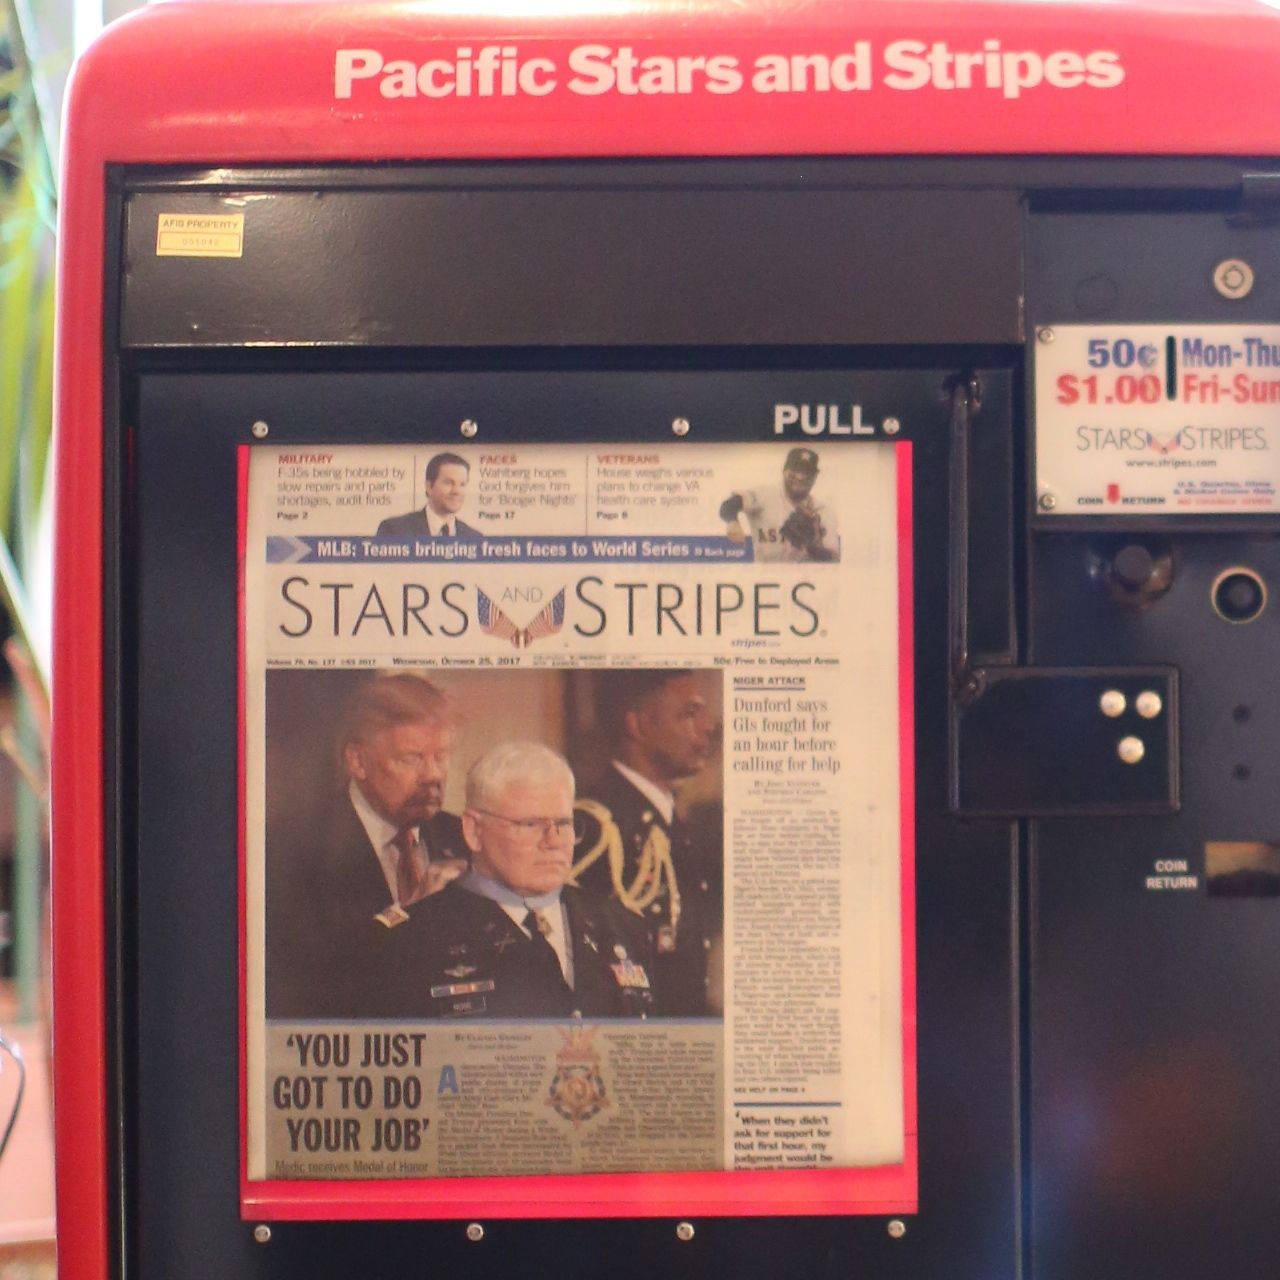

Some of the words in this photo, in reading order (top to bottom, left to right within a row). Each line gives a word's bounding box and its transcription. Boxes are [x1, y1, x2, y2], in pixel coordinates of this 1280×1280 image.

[333, 47, 556, 100] Pacific
[567, 44, 742, 95] Stars
[752, 41, 872, 93] and
[884, 39, 1125, 99] Stripes
[187, 220, 238, 229] PROPERTY
[1057, 374, 1162, 406] $1.00
[774, 404, 875, 435] PULL
[1077, 426, 1147, 451] STARS
[278, 454, 333, 464] MILITARY
[479, 455, 517, 464] FACES
[597, 455, 660, 464] VETERANS
[1126, 459, 1217, 470] www.stripes.com
[312, 468, 342, 480] being
[345, 468, 390, 478] hobbled
[392, 468, 405, 480] by
[479, 468, 530, 480] Wahlberg
[533, 468, 567, 480] hopes
[596, 468, 628, 478] House
[676, 468, 714, 478] various
[277, 482, 300, 492] slow
[305, 482, 340, 494] repairs
[344, 482, 365, 492] and
[368, 482, 396, 494] parts
[478, 482, 501, 492] God
[502, 482, 546, 493] forgives
[549, 482, 570, 492] him
[596, 482, 626, 493] plans
[629, 483, 639, 491] to
[642, 482, 681, 493] change
[684, 482, 700, 491] VA
[277, 496, 331, 507] shortages,
[335, 496, 361, 506] audit
[365, 496, 392, 506] finds
[478, 495, 494, 505] for
[596, 495, 630, 505] health
[633, 497, 656, 505] care
[659, 496, 699, 507] system
[1077, 497, 1104, 505] COIN
[1121, 497, 1166, 505] RETURN
[277, 512, 299, 521] Page
[317, 542, 356, 558] MLB:
[362, 542, 410, 558] Teams
[415, 541, 477, 560] bringing
[481, 541, 521, 557] fresh
[526, 542, 567, 557] faces
[572, 543, 588, 557] to
[592, 542, 637, 557] World
[641, 542, 690, 557] Series
[279, 576, 469, 637] STARS
[500, 586, 544, 604] AND
[573, 576, 820, 638] STRIPES
[496, 656, 521, 666] 2017
[770, 656, 812, 668] Deployed
[814, 656, 840, 666] Areas
[733, 676, 764, 685] NIGER
[768, 676, 807, 685] ATTACK
[733, 697, 791, 712] Dunford
[796, 700, 828, 717] says
[733, 717, 757, 733] GIs
[762, 717, 806, 736] fought
[812, 717, 831, 732] for
[733, 740, 751, 752] an
[756, 736, 789, 752] hour
[793, 736, 838, 752] before
[733, 756, 784, 775] calling
[788, 756, 807, 771] for
[811, 756, 841, 775] help
[1155, 860, 1188, 873] COIN
[1146, 876, 1198, 890] RETURN
[360, 1033, 427, 1068] JUST
[437, 1064, 459, 1094] A
[272, 1075, 328, 1109] GOT
[337, 1075, 373, 1109] TO
[383, 1075, 422, 1109] DO
[774, 1116, 796, 1128] they
[286, 1118, 361, 1153] YOUR
[733, 1128, 752, 1138] ask
[755, 1128, 770, 1138] for
[773, 1129, 815, 1140] support
[817, 1128, 832, 1138] for
[733, 1141, 754, 1151] that
[757, 1141, 779, 1151] first
[781, 1141, 808, 1152] hour,
[811, 1144, 827, 1153] my
[733, 1154, 784, 1164] judgment
[786, 1154, 818, 1163] would
[819, 1154, 833, 1163] be
[275, 1160, 307, 1171] Medic
[308, 1161, 350, 1172] receives
[353, 1160, 384, 1171] Medal
[386, 1160, 398, 1171] of
[400, 1160, 429, 1171] Honor
